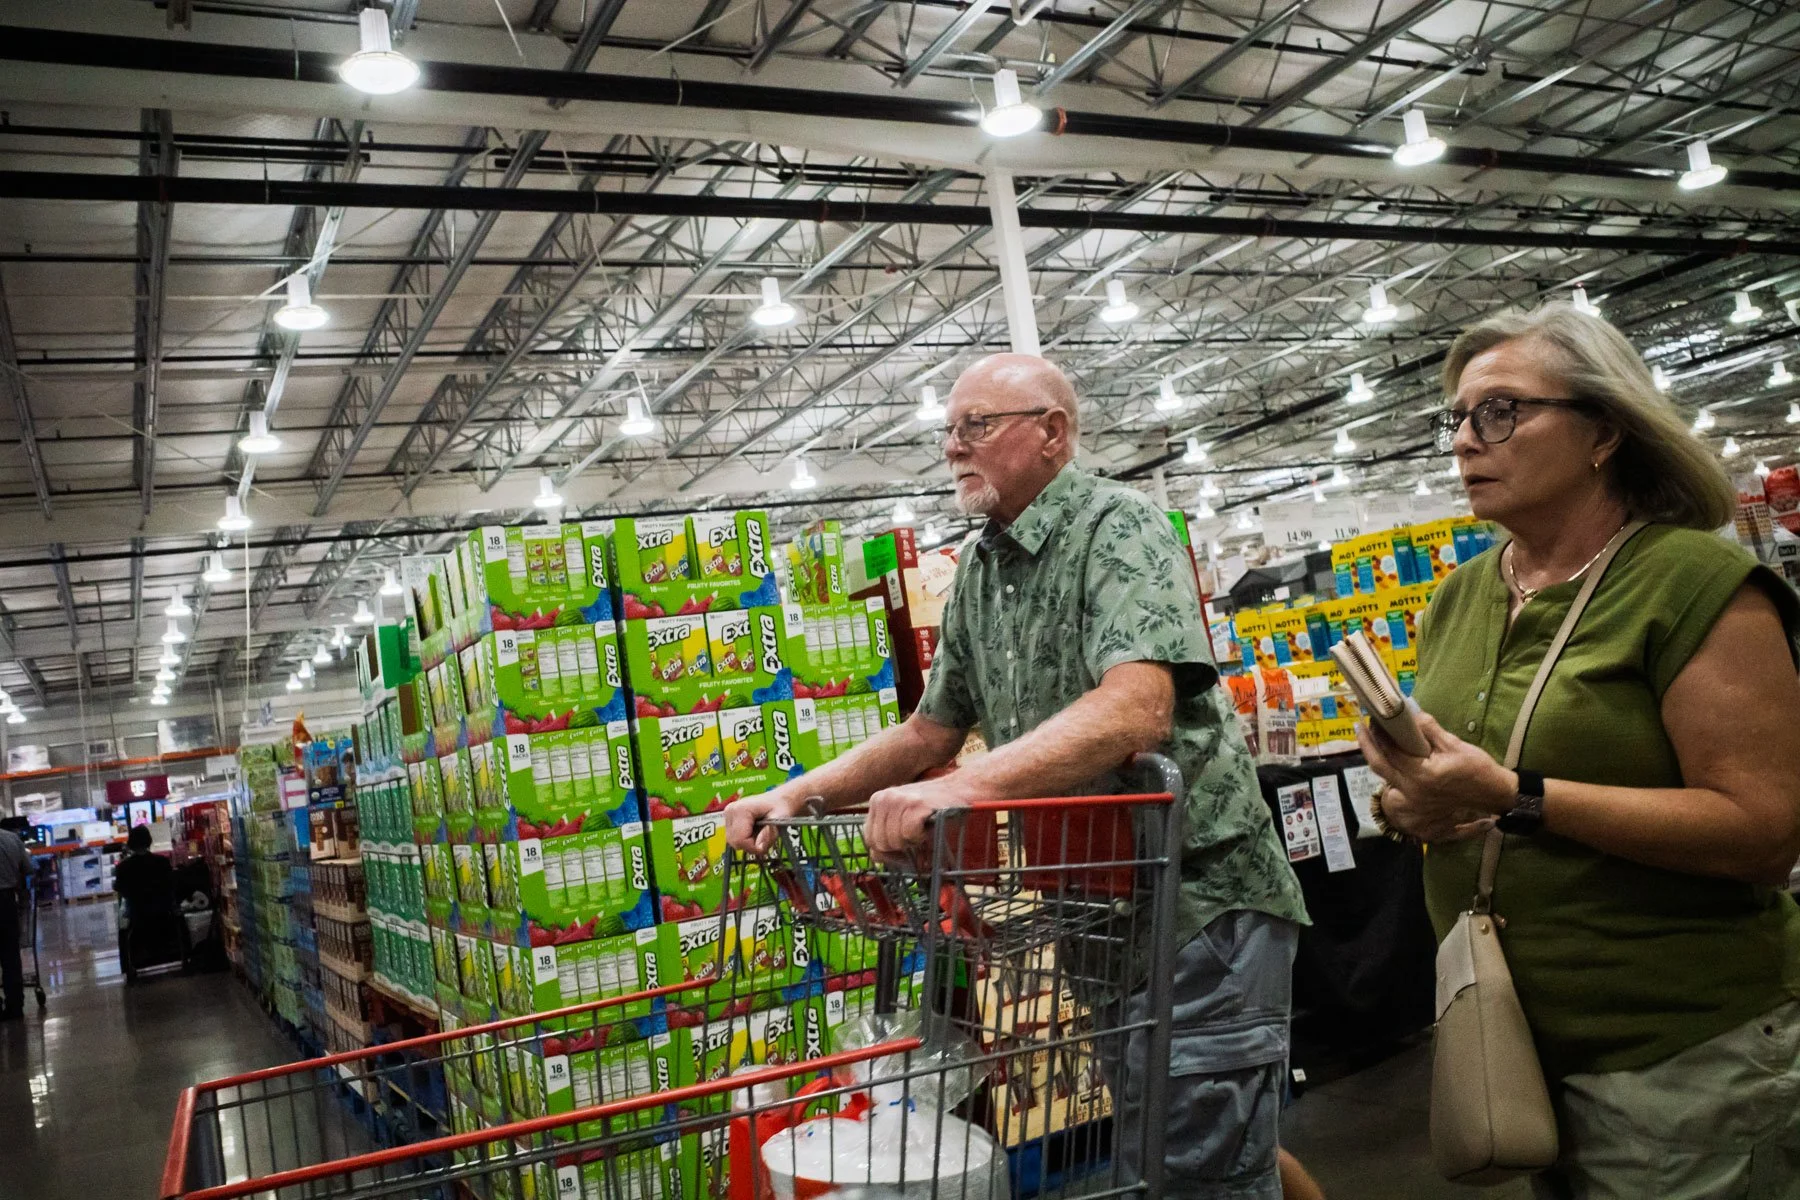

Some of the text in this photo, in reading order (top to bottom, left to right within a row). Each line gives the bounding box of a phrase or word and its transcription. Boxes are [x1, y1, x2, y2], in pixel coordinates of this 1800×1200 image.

[489, 536, 501, 546] 18
[637, 529, 674, 550] xtra
[709, 525, 738, 548] Ext
[1287, 530, 1312, 543] 14.99
[1335, 528, 1360, 539] 11.99
[746, 518, 770, 578] Extra
[591, 545, 607, 588] Extra
[644, 563, 664, 584] Extra
[704, 556, 724, 575] Extra
[687, 582, 709, 590] FRUITY
[830, 564, 842, 594] Extra
[502, 639, 514, 648] 18
[722, 620, 751, 646] Ext
[874, 618, 890, 658] Extra
[759, 613, 783, 675] Extra
[604, 644, 622, 688] Extra
[662, 658, 682, 680] Extra
[688, 656, 706, 676] Extra
[716, 652, 736, 673] Extra
[722, 678, 753, 686] FAVORITES
[734, 717, 764, 743] Ext
[772, 709, 796, 772] Extra
[1299, 731, 1320, 739] OTT'S
[514, 744, 526, 754] 18
[616, 746, 634, 790] Extra
[675, 758, 695, 780] Extra
[701, 755, 720, 776] Extra
[728, 750, 748, 770] Extra
[712, 774, 766, 788] FRUITY FAVORITES
[525, 848, 537, 857] 18
[631, 845, 648, 890] Extra
[687, 858, 707, 880] Extra
[540, 956, 551, 966] 18
[830, 1000, 840, 1008] 18
[552, 1064, 563, 1074] 18
[656, 1057, 669, 1092] xtra
[561, 1178, 572, 1188] 18
